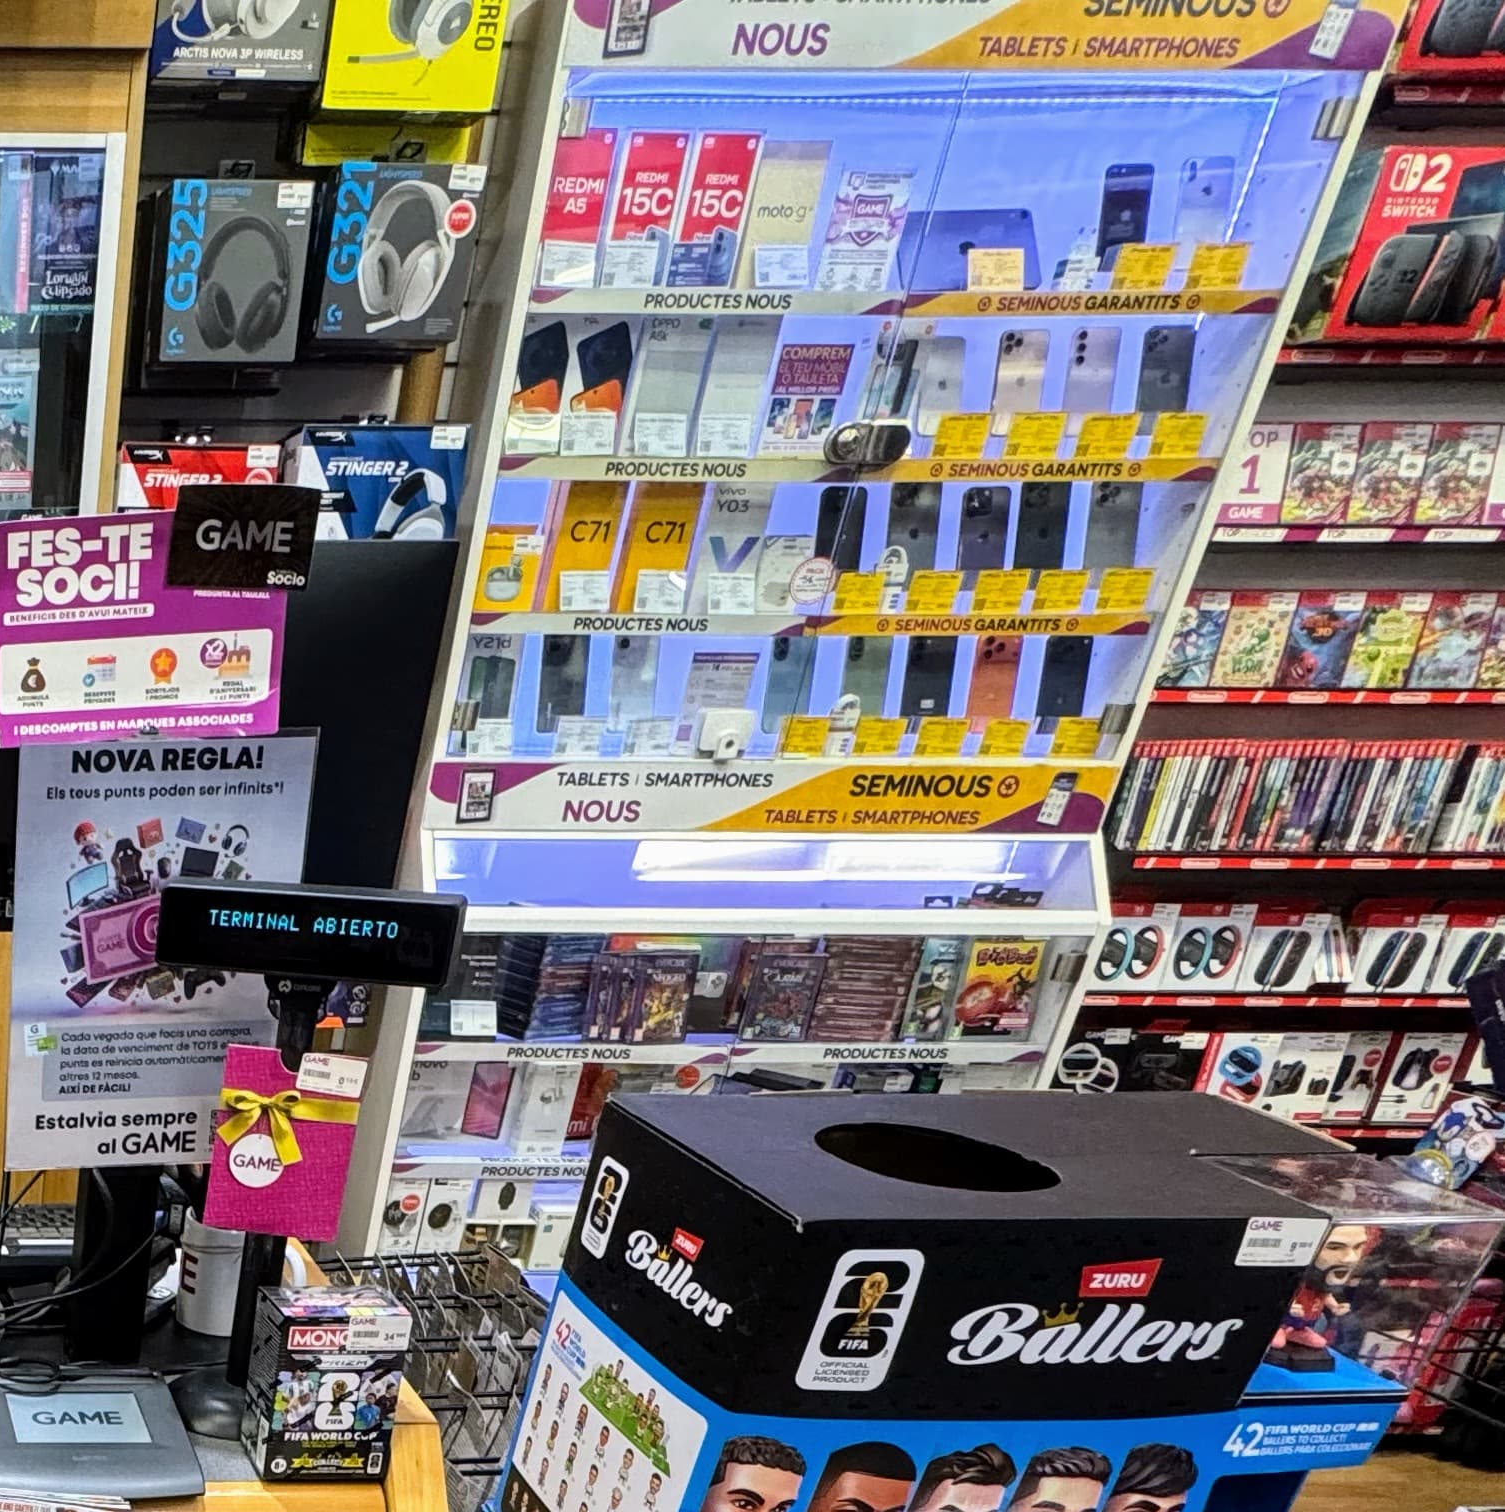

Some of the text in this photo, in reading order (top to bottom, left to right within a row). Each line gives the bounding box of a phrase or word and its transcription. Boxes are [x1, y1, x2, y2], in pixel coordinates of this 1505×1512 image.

[732, 23, 831, 56] NOUS
[173, 47, 208, 60] ARCTIS
[211, 48, 237, 60] NOVA
[254, 48, 304, 60] WIRELESS
[554, 177, 605, 195] REDMI
[635, 172, 669, 185] REDMI
[563, 198, 587, 214] A5
[622, 187, 674, 216] 15C
[757, 204, 793, 219] moto
[1382, 204, 1437, 219] SWITCH
[326, 162, 378, 284] G321
[165, 180, 208, 311] G325
[644, 294, 792, 309] PRODUCTES NOUS
[997, 295, 1179, 311] SEMINOUS GARANTITS
[327, 461, 409, 476] STINGER 2
[1239, 455, 1261, 495] 1
[717, 499, 749, 514] Y03
[1228, 506, 1264, 520] GAME
[196, 519, 294, 553] GAME
[570, 521, 610, 544] C71
[7, 523, 154, 569] FES-TE
[16, 562, 140, 607] SOCI!
[267, 571, 305, 586] Socio
[10, 607, 148, 623] BENEFICIS DES D'AVUI MATEIX
[20, 721, 97, 735] DESCOMPTES
[100, 720, 115, 730] EN
[178, 713, 253, 728] ASSOCIADES
[72, 745, 264, 774] NOVA REGLA!
[47, 787, 65, 799] Els
[103, 786, 145, 802] punts
[148, 784, 196, 801] poden
[200, 785, 222, 797] ser
[849, 775, 993, 797] SEMINOUS
[562, 800, 641, 823] NOUS
[765, 810, 980, 825] TABLETS SMARTPHONES
[210, 909, 399, 938] TERMINAL ABIERTO
[61, 1032, 91, 1042] Cada
[93, 1031, 134, 1043] vegada
[136, 1031, 157, 1042] que
[186, 1029, 207, 1037] una
[304, 1055, 330, 1066] GAME
[83, 1085, 95, 1093] DE
[35, 1111, 197, 1130] Estalvia sempre
[98, 1131, 197, 1154] al GAME
[232, 1153, 282, 1172] GAME
[1250, 1220, 1283, 1233] GAME
[1089, 1273, 1146, 1289] ZURU
[950, 1302, 1243, 1365] Ballers
[838, 1339, 868, 1350] FIFA
[812, 1376, 867, 1384] PRODUCT
[32, 1411, 123, 1426] GAME
[284, 1432, 309, 1441] FIFA
[311, 1432, 352, 1441] WORLD
[1223, 1422, 1356, 1457] 42 FIFA WORLD CUP
